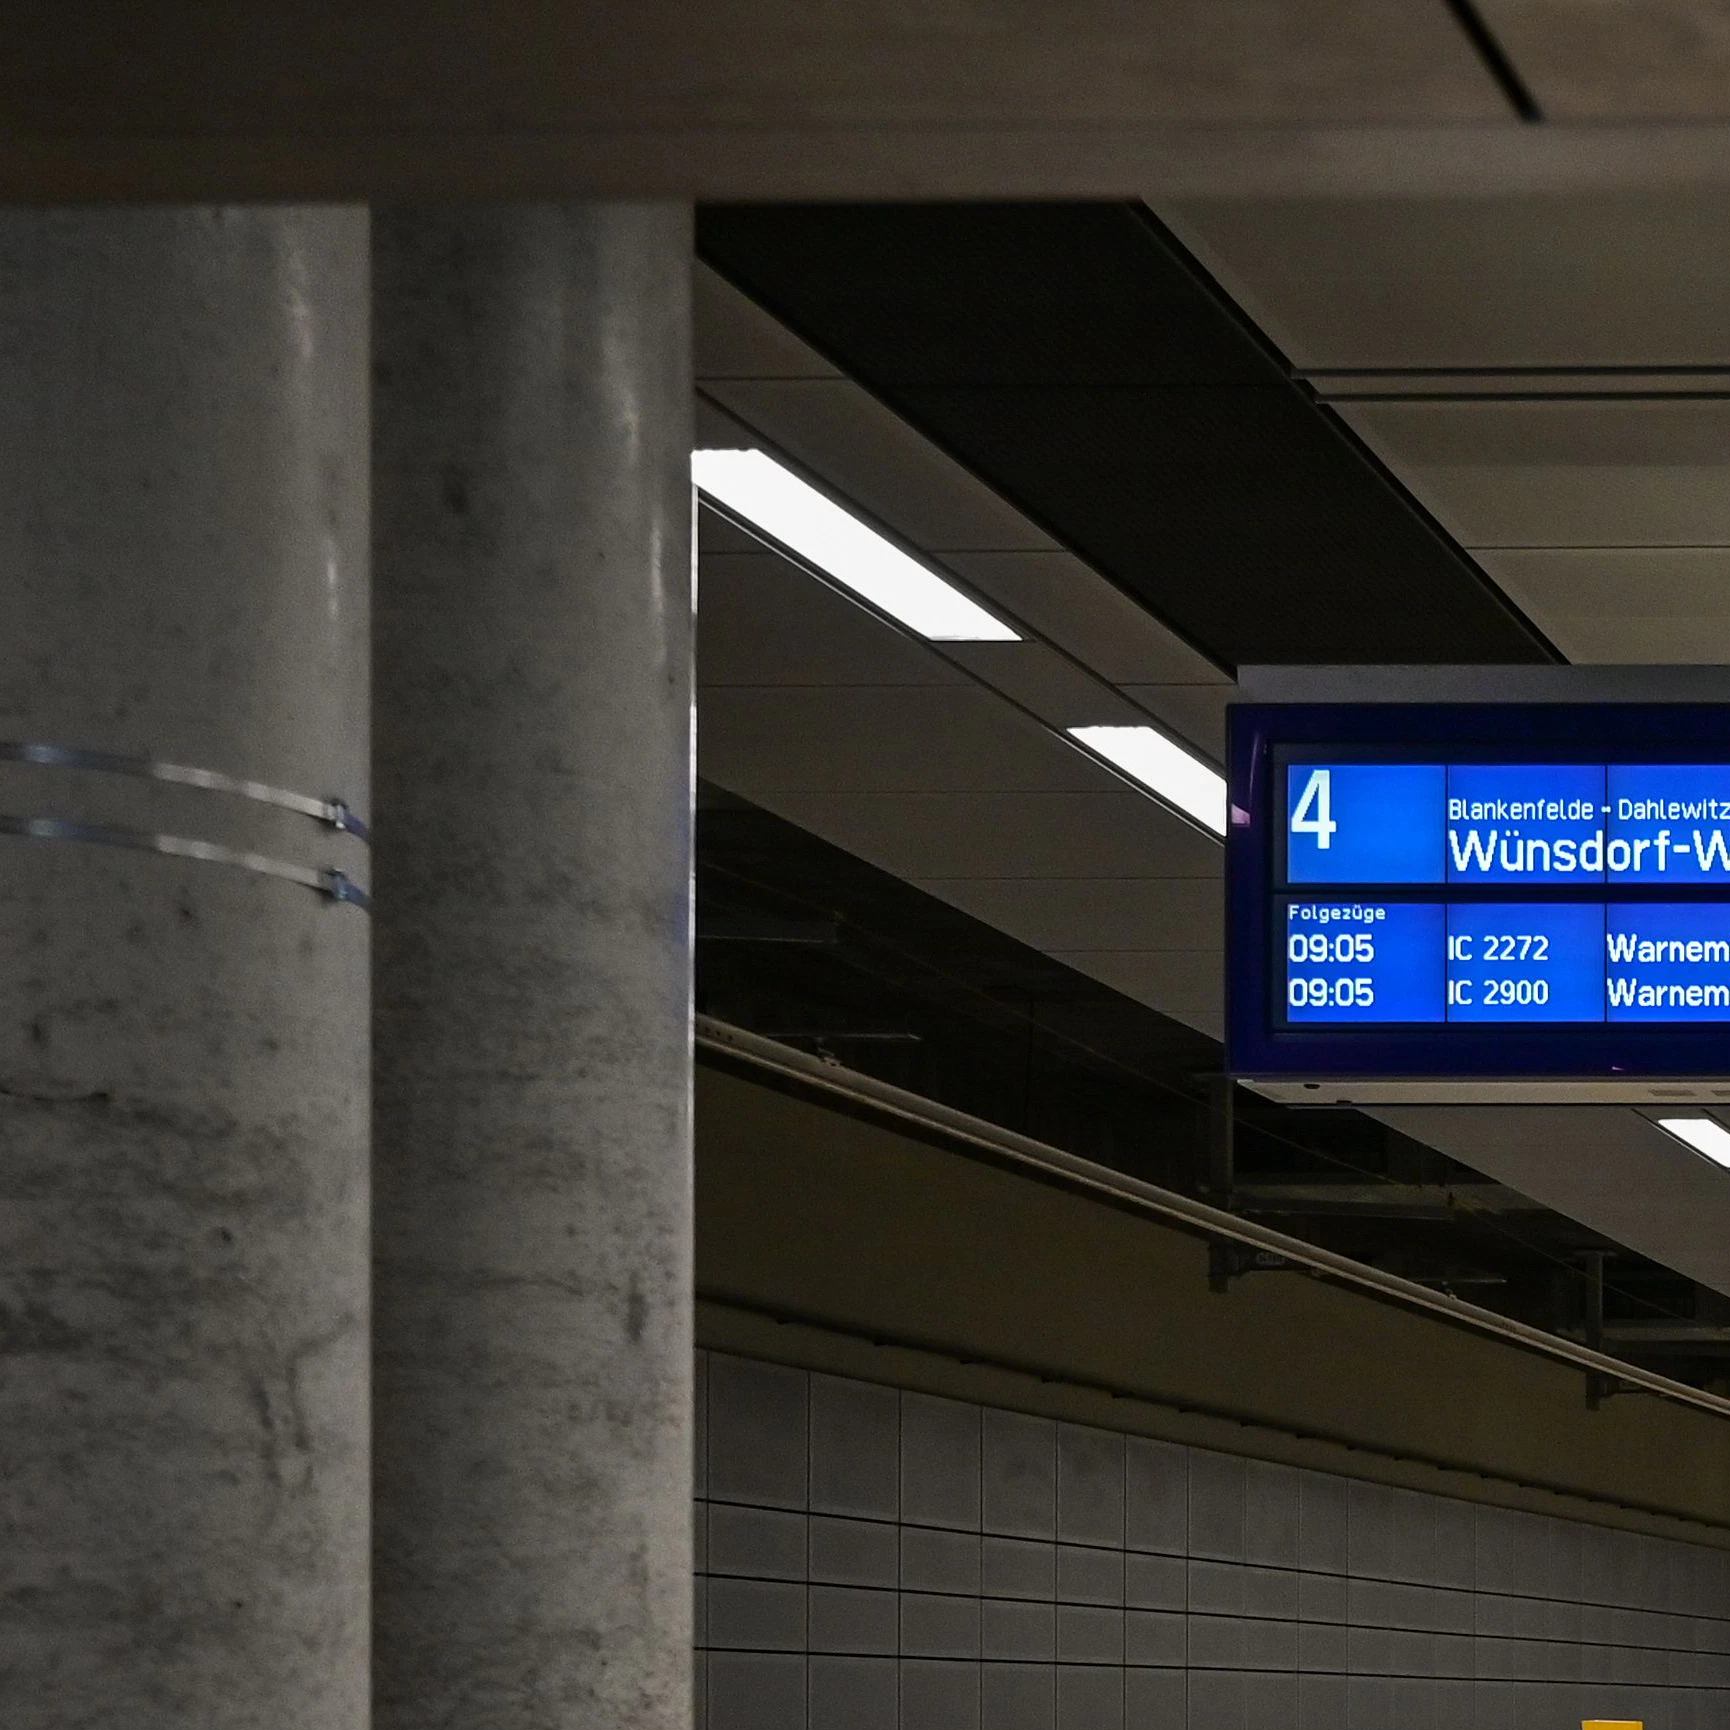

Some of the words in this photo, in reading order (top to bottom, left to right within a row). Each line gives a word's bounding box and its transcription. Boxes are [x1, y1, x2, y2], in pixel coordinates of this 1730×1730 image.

[1291, 769, 1337, 849] 4
[1449, 798, 1594, 820] Blankenfelde
[1289, 904, 1386, 924] Folgezüge
[1287, 933, 1374, 963] 09:05
[1448, 935, 1473, 961] IC
[1483, 935, 1549, 961] 2272
[1287, 978, 1374, 1007] 09:05
[1448, 979, 1473, 1005] IC
[1483, 979, 1549, 1005] 2900
